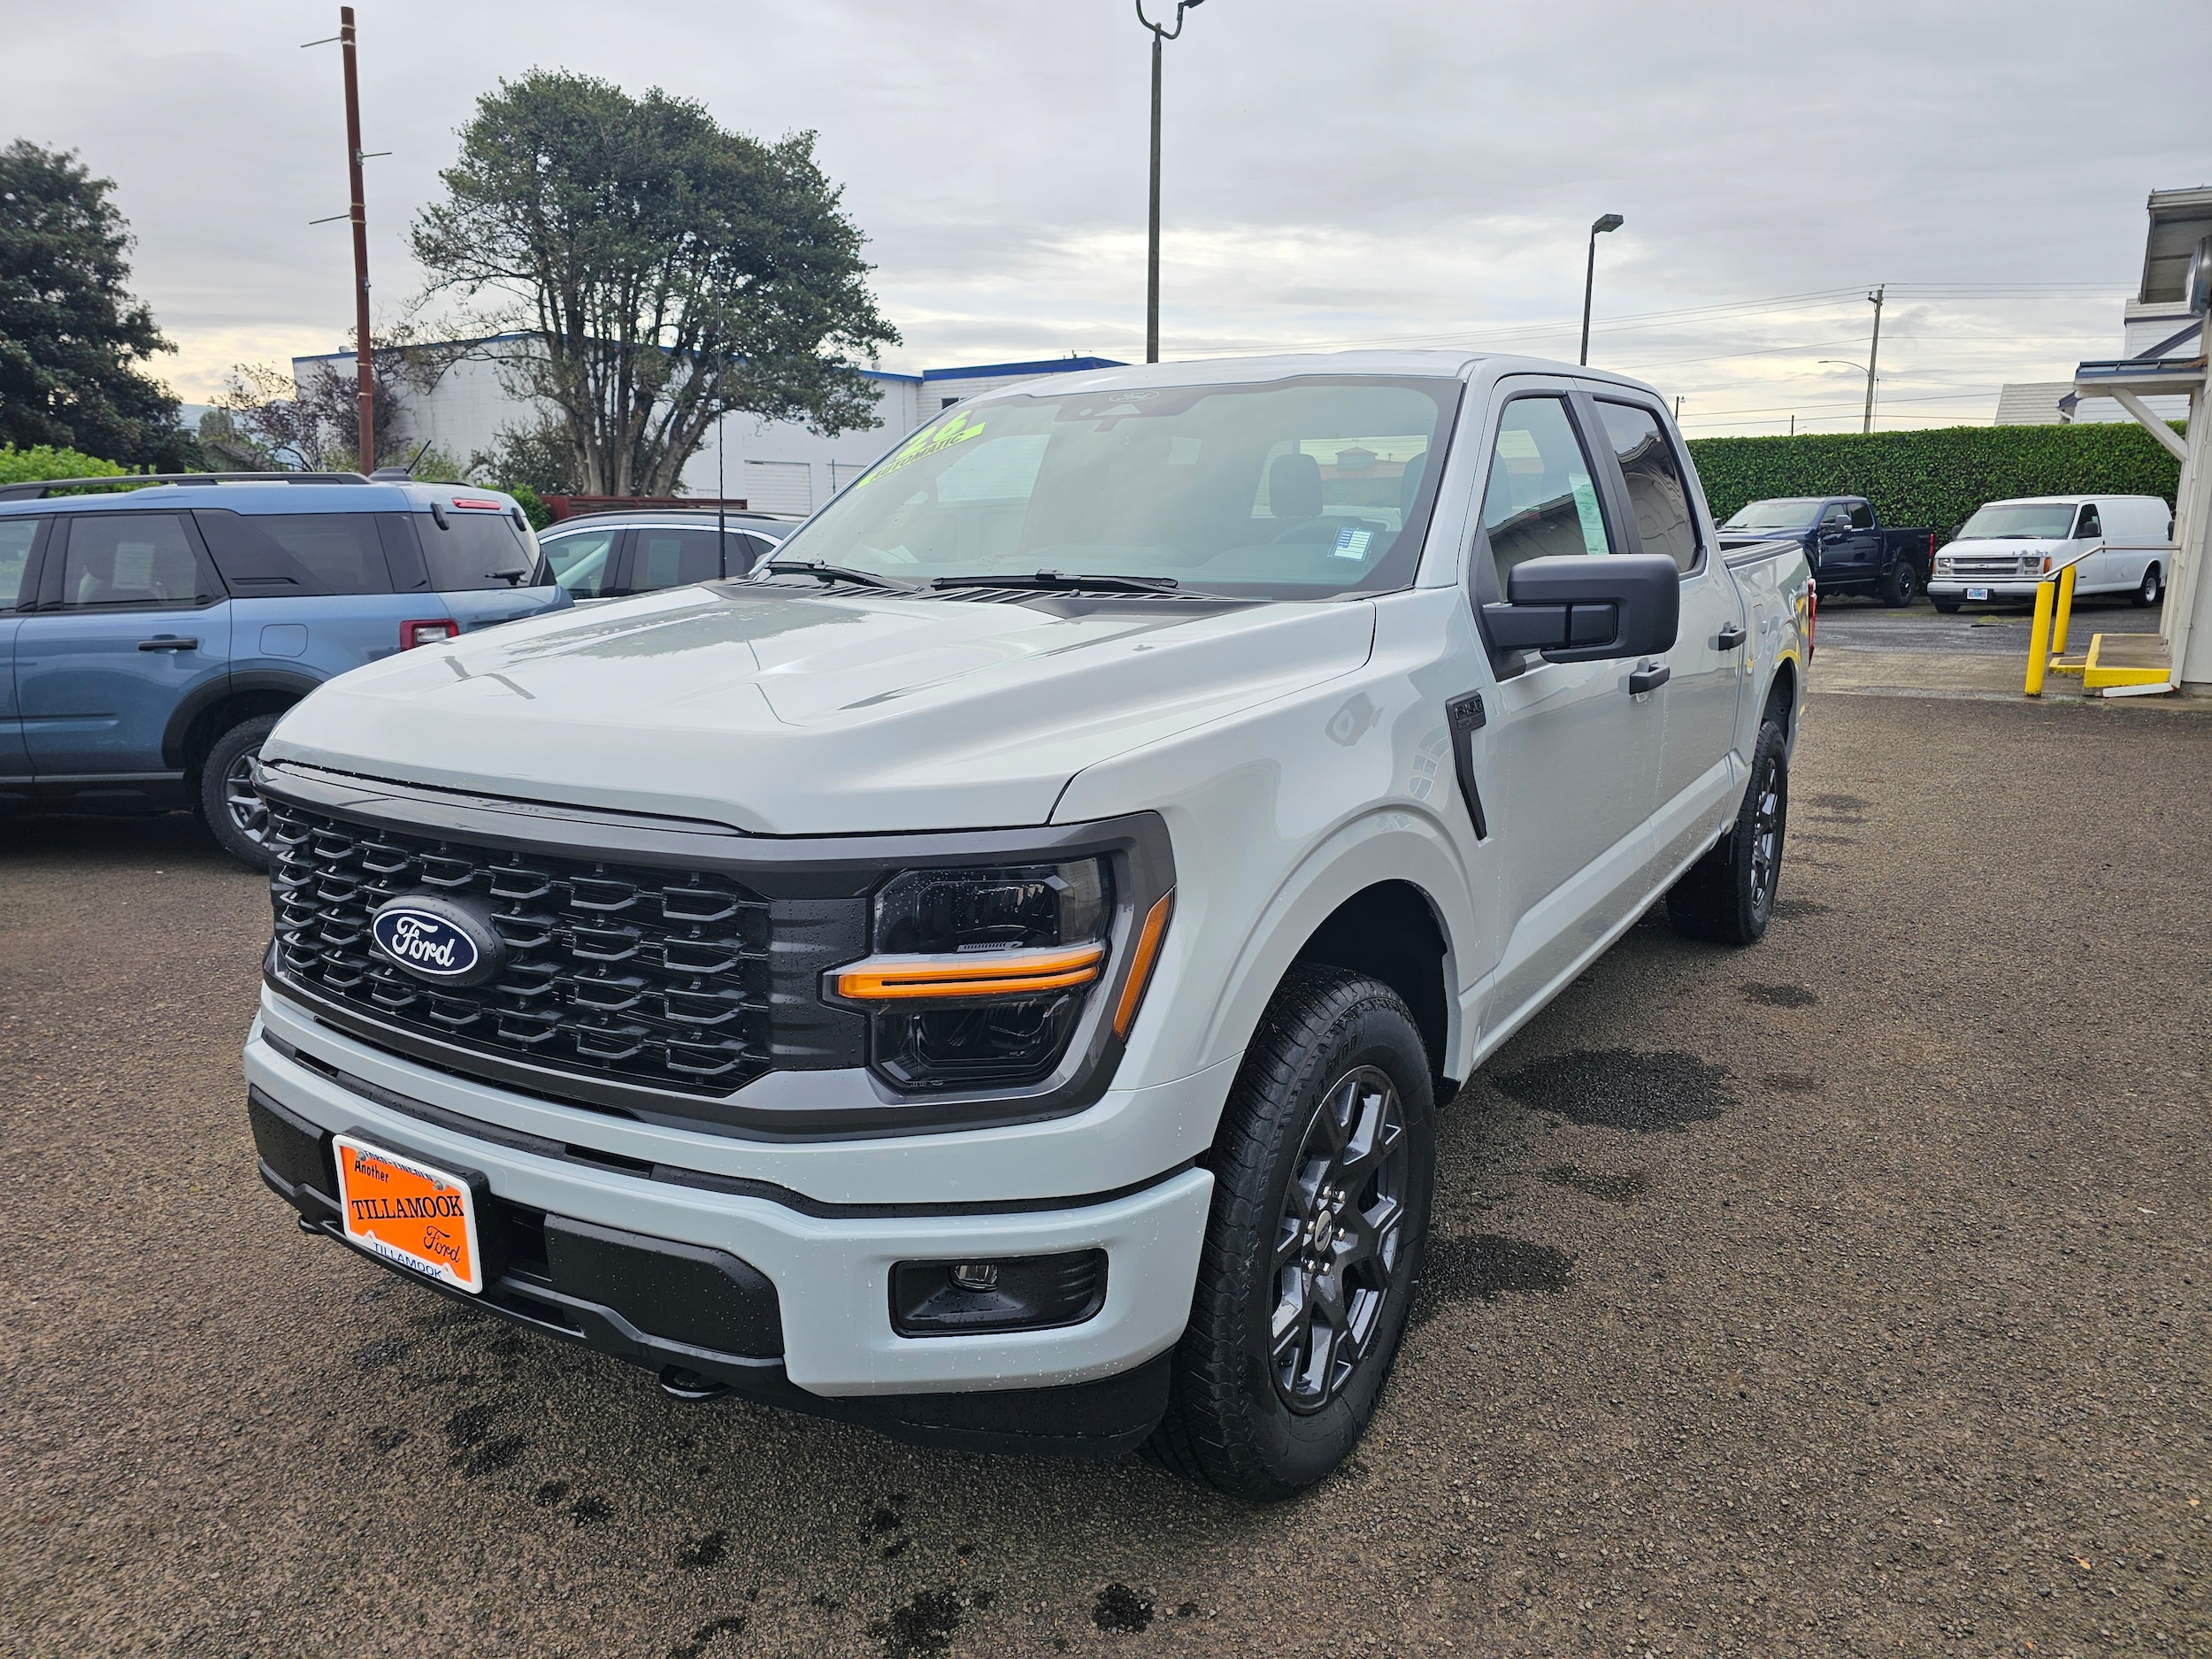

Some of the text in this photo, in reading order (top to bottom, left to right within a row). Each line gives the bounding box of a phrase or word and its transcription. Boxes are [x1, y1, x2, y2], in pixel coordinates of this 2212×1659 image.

[895, 410, 972, 460] 26
[869, 433, 964, 482] AUTOMATIC
[392, 916, 456, 967] Ford
[355, 1160, 389, 1183] Another
[351, 1195, 465, 1220] TILLAMOOK
[373, 1242, 442, 1279] TILLAMOOK
[423, 1225, 461, 1263] Ford
